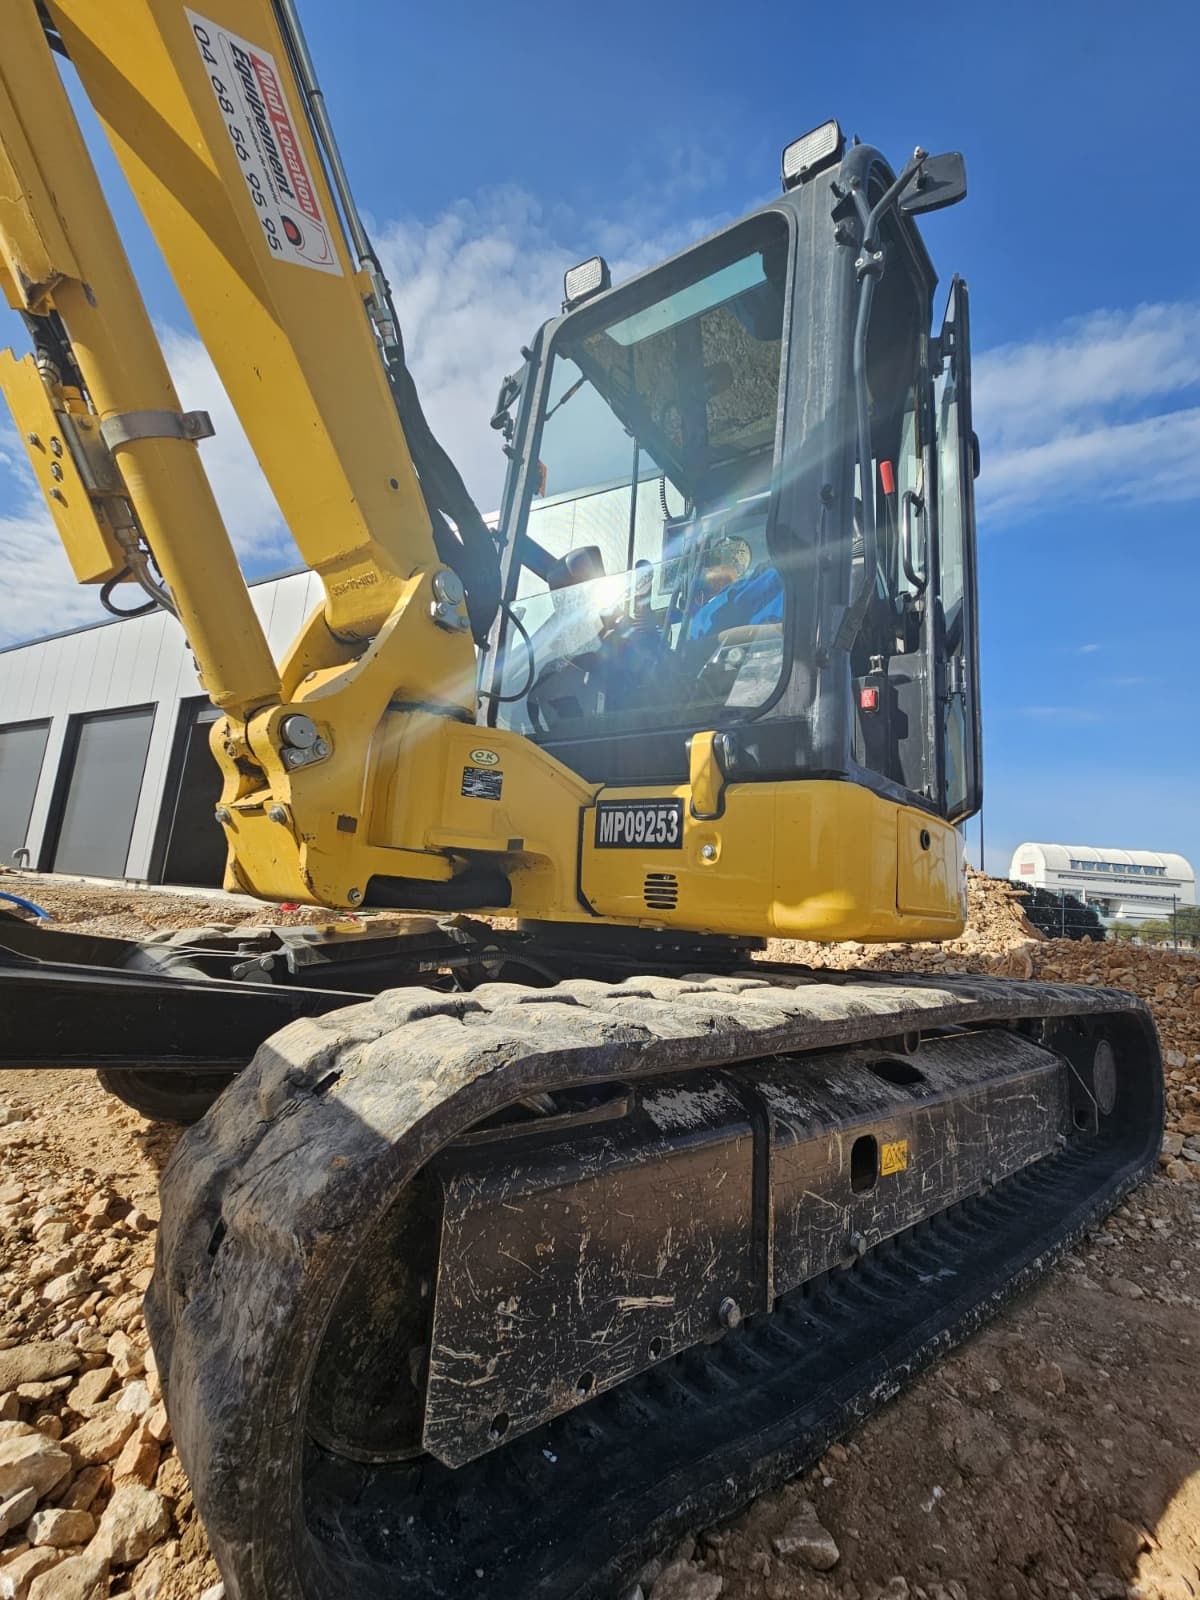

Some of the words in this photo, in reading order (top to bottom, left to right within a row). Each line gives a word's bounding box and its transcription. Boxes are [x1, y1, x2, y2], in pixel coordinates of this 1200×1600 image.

[193, 24, 218, 66] 04
[211, 75, 235, 115] 68
[229, 124, 251, 162] 56
[246, 172, 268, 208] 95
[262, 217, 283, 251] 95
[257, 63, 285, 118] Midi
[276, 120, 315, 216] Location
[600, 810, 679, 843] MP09253
